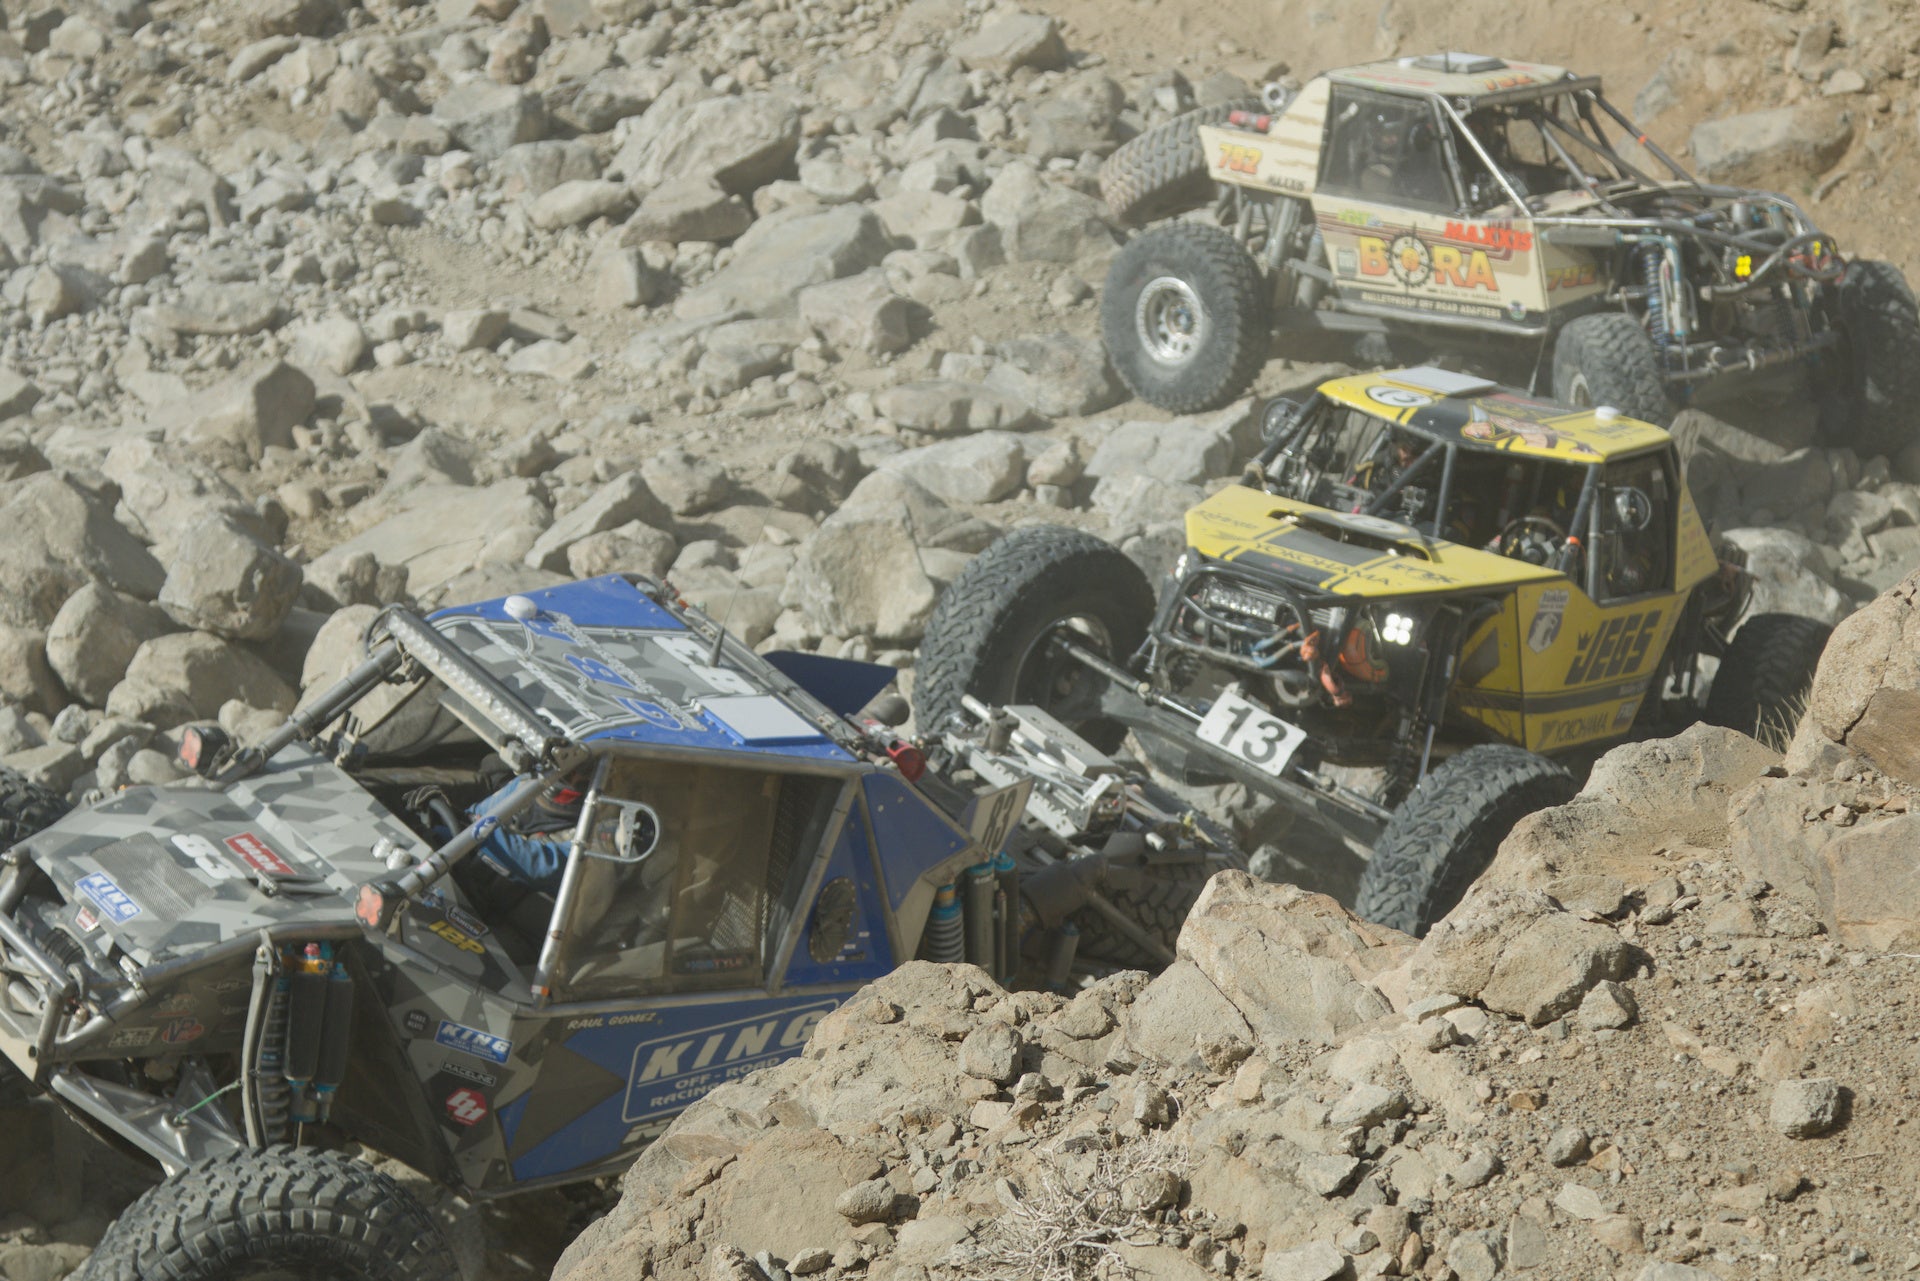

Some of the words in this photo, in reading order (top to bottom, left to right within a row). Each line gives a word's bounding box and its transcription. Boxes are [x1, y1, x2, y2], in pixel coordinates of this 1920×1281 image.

[1443, 220, 1534, 252] MAXXIS
[1359, 232, 1499, 292] BORA
[1255, 542, 1389, 586] YOKOHAMA
[1564, 610, 1662, 685] JEGS
[1219, 704, 1287, 764] 13
[981, 788, 1018, 853] 83
[170, 833, 247, 879] 83
[88, 875, 138, 917] KING
[440, 1023, 511, 1053] KING
[567, 1017, 605, 1031] RAUL
[608, 1012, 657, 1027] GOMEZ
[638, 1009, 830, 1084] KING
[444, 1063, 493, 1085] RACELINE
[674, 1073, 713, 1090] OFF
[725, 1057, 781, 1078] ROAD
